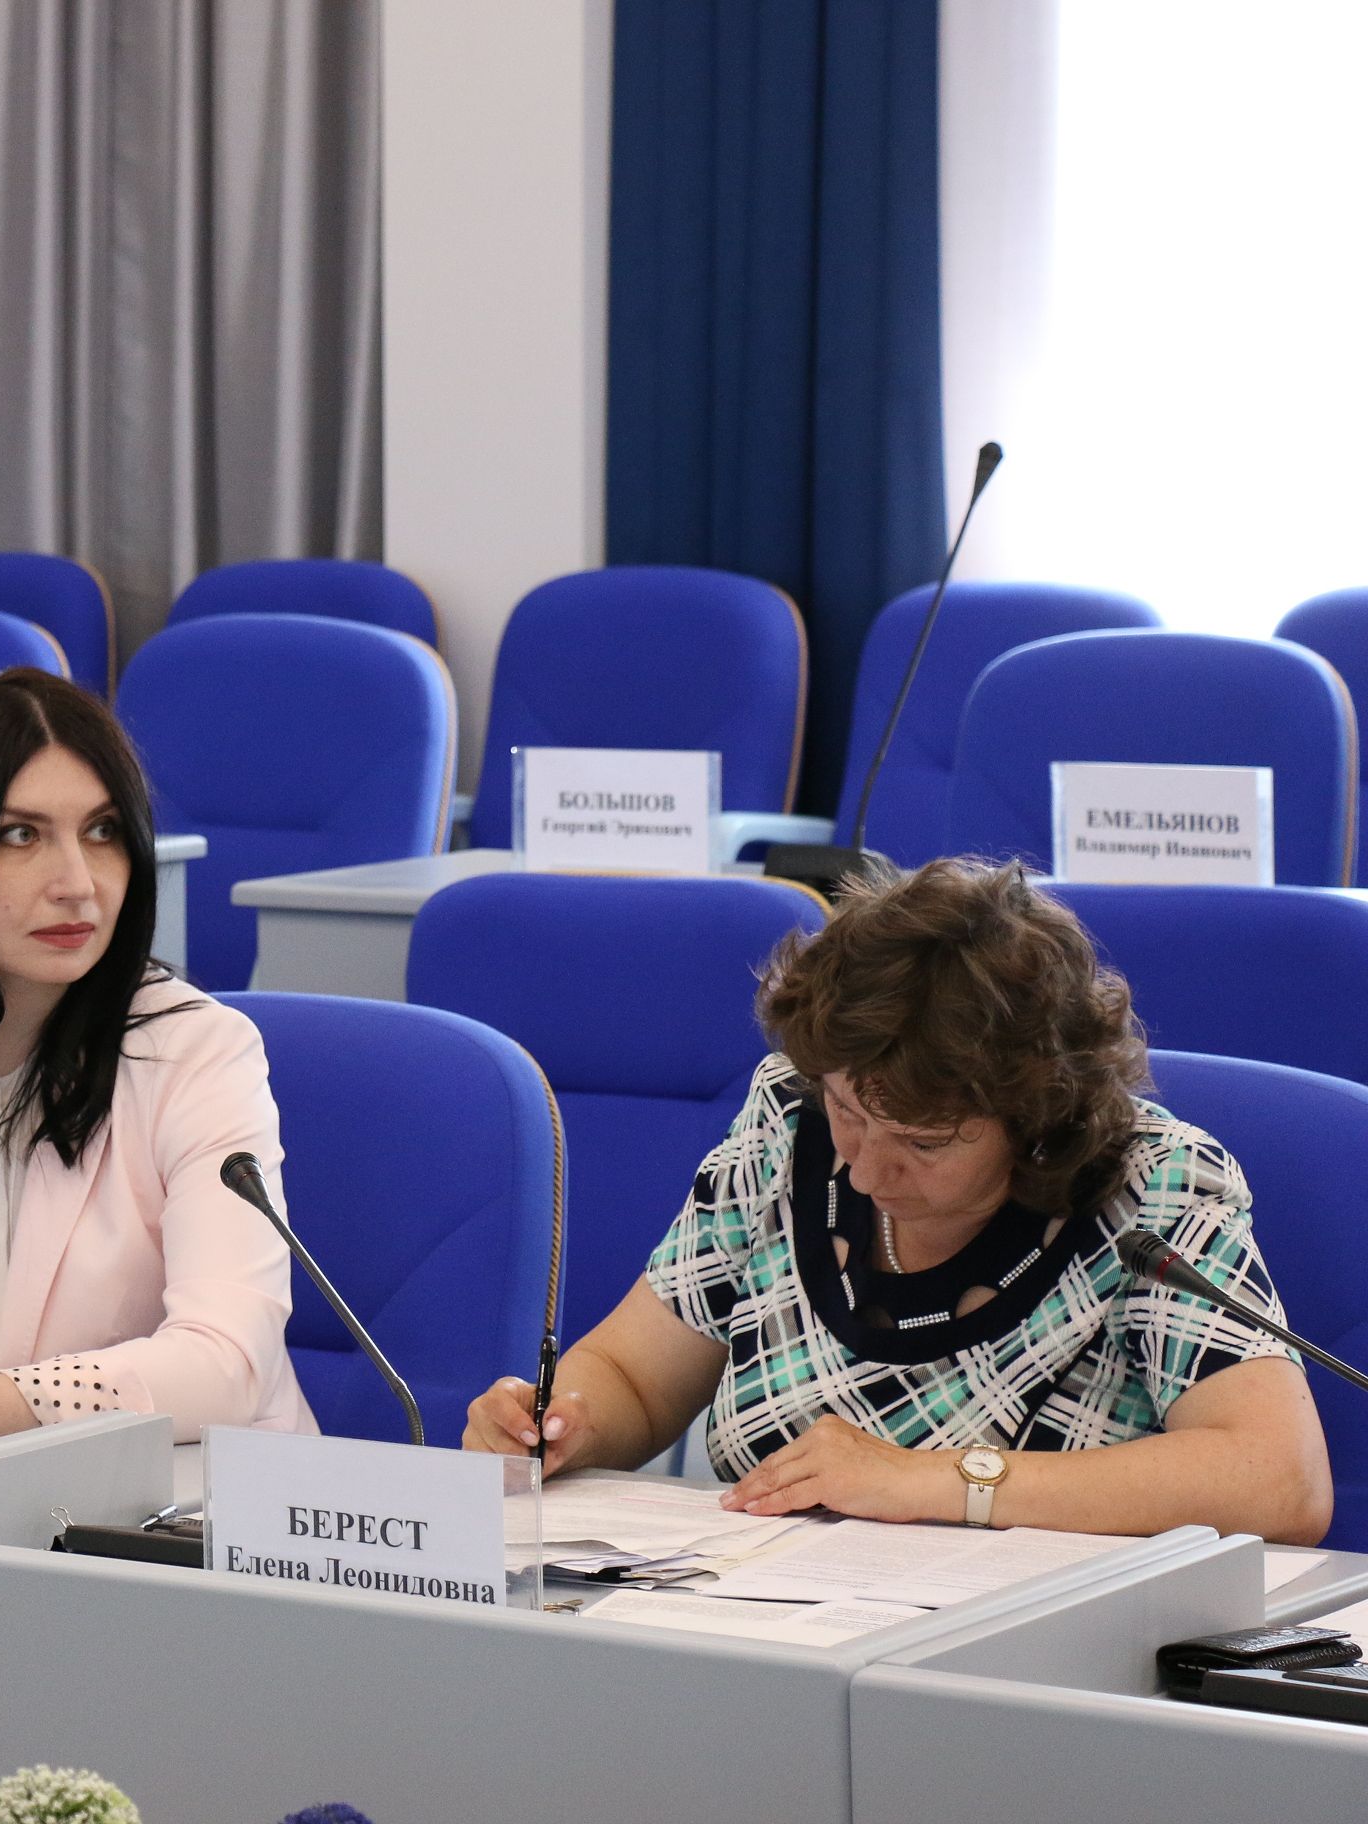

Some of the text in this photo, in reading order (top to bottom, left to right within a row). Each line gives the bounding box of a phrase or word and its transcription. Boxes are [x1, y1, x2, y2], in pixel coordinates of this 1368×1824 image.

[558, 791, 676, 812] БОЛЬШОВ
[1086, 809, 1240, 834] ЕМЕЛЬЯНОВ
[1076, 837, 1252, 860] Владимир Иванович
[287, 1506, 428, 1550] БЕРЕСТ
[226, 1545, 495, 1605] Елена Леонидовна
